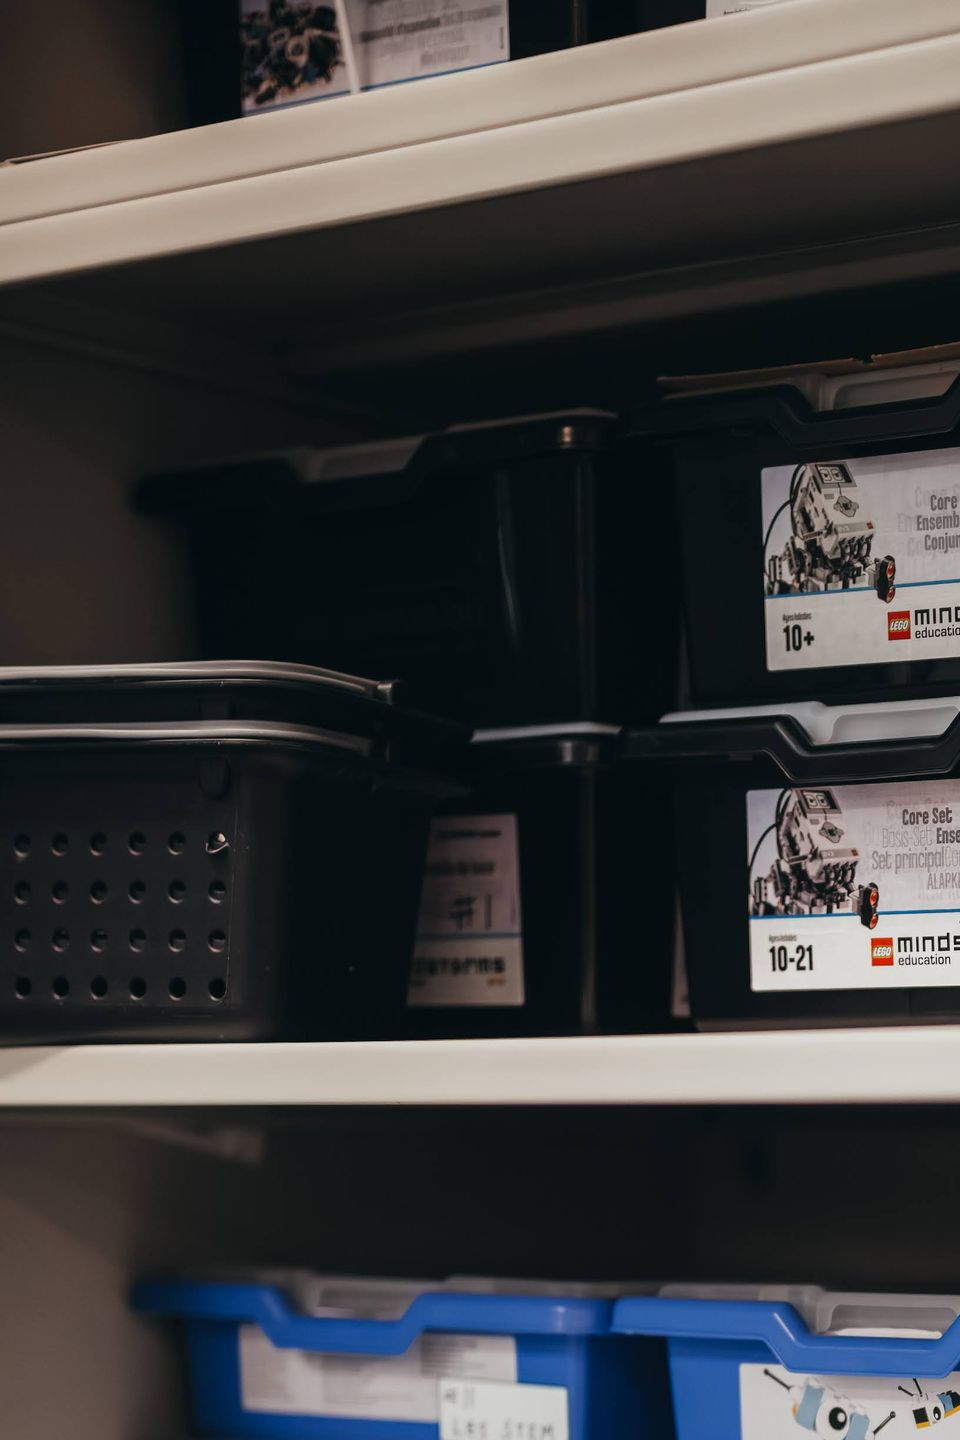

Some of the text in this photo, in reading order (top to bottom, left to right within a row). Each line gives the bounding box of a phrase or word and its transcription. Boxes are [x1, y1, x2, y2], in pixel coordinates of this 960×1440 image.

[930, 494, 958, 511] Core
[783, 624, 815, 651] 10+
[902, 807, 953, 826] Core Set
[872, 850, 892, 870] Set
[895, 847, 944, 874] principal
[768, 944, 814, 972] 10-21
[898, 953, 951, 965] education
